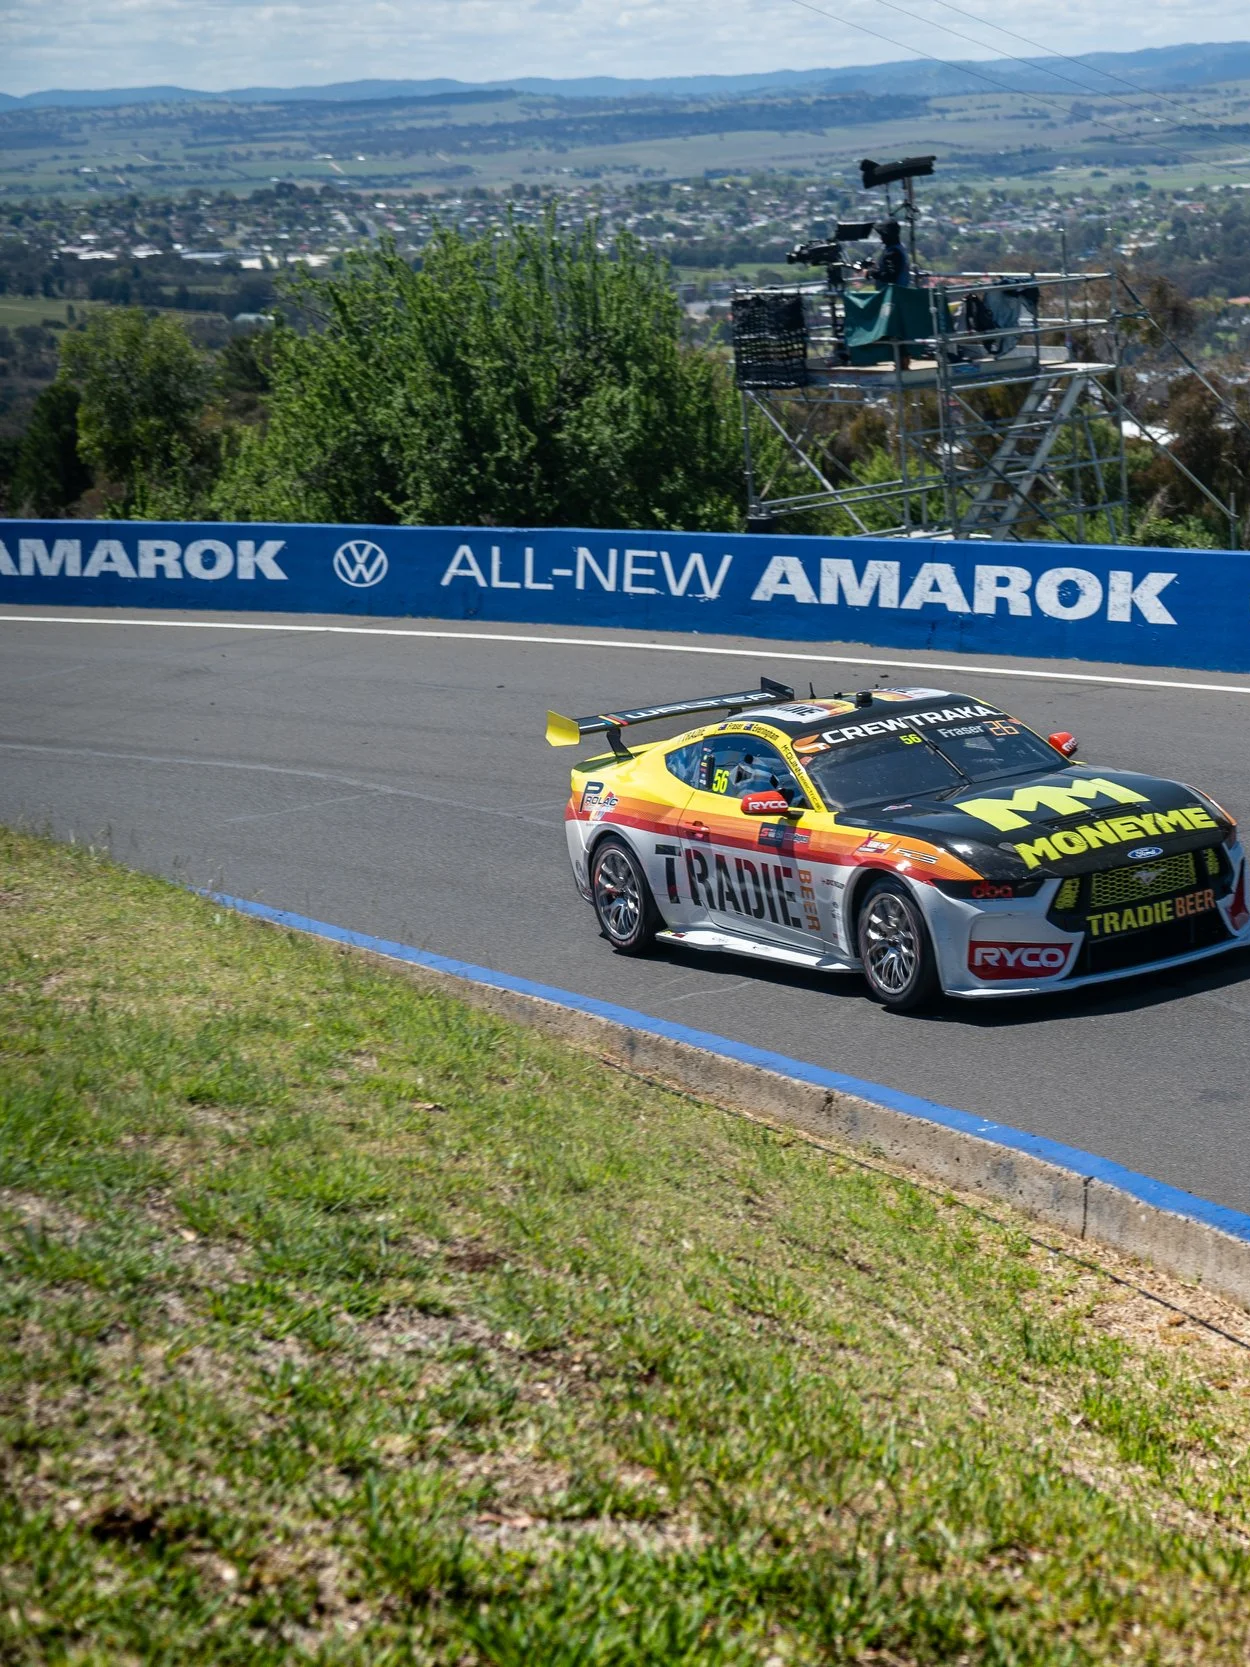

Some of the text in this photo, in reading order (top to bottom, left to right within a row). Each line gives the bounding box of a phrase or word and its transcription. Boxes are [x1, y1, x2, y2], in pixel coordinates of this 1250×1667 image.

[440, 544, 1178, 625] ALL-NEW AMAROK
[624, 691, 776, 719] WALTER
[820, 705, 1004, 745] CREWTRAKA
[937, 725, 985, 738] Fraser
[982, 719, 1021, 737] 26
[900, 733, 922, 745] 56
[712, 768, 730, 794] 56
[748, 800, 789, 811] RYCO
[1013, 807, 1219, 870] MONEYME
[655, 843, 802, 929] TRADIE
[971, 880, 1014, 899] dba
[798, 869, 821, 931] BEER
[974, 946, 1065, 969] RYCO
